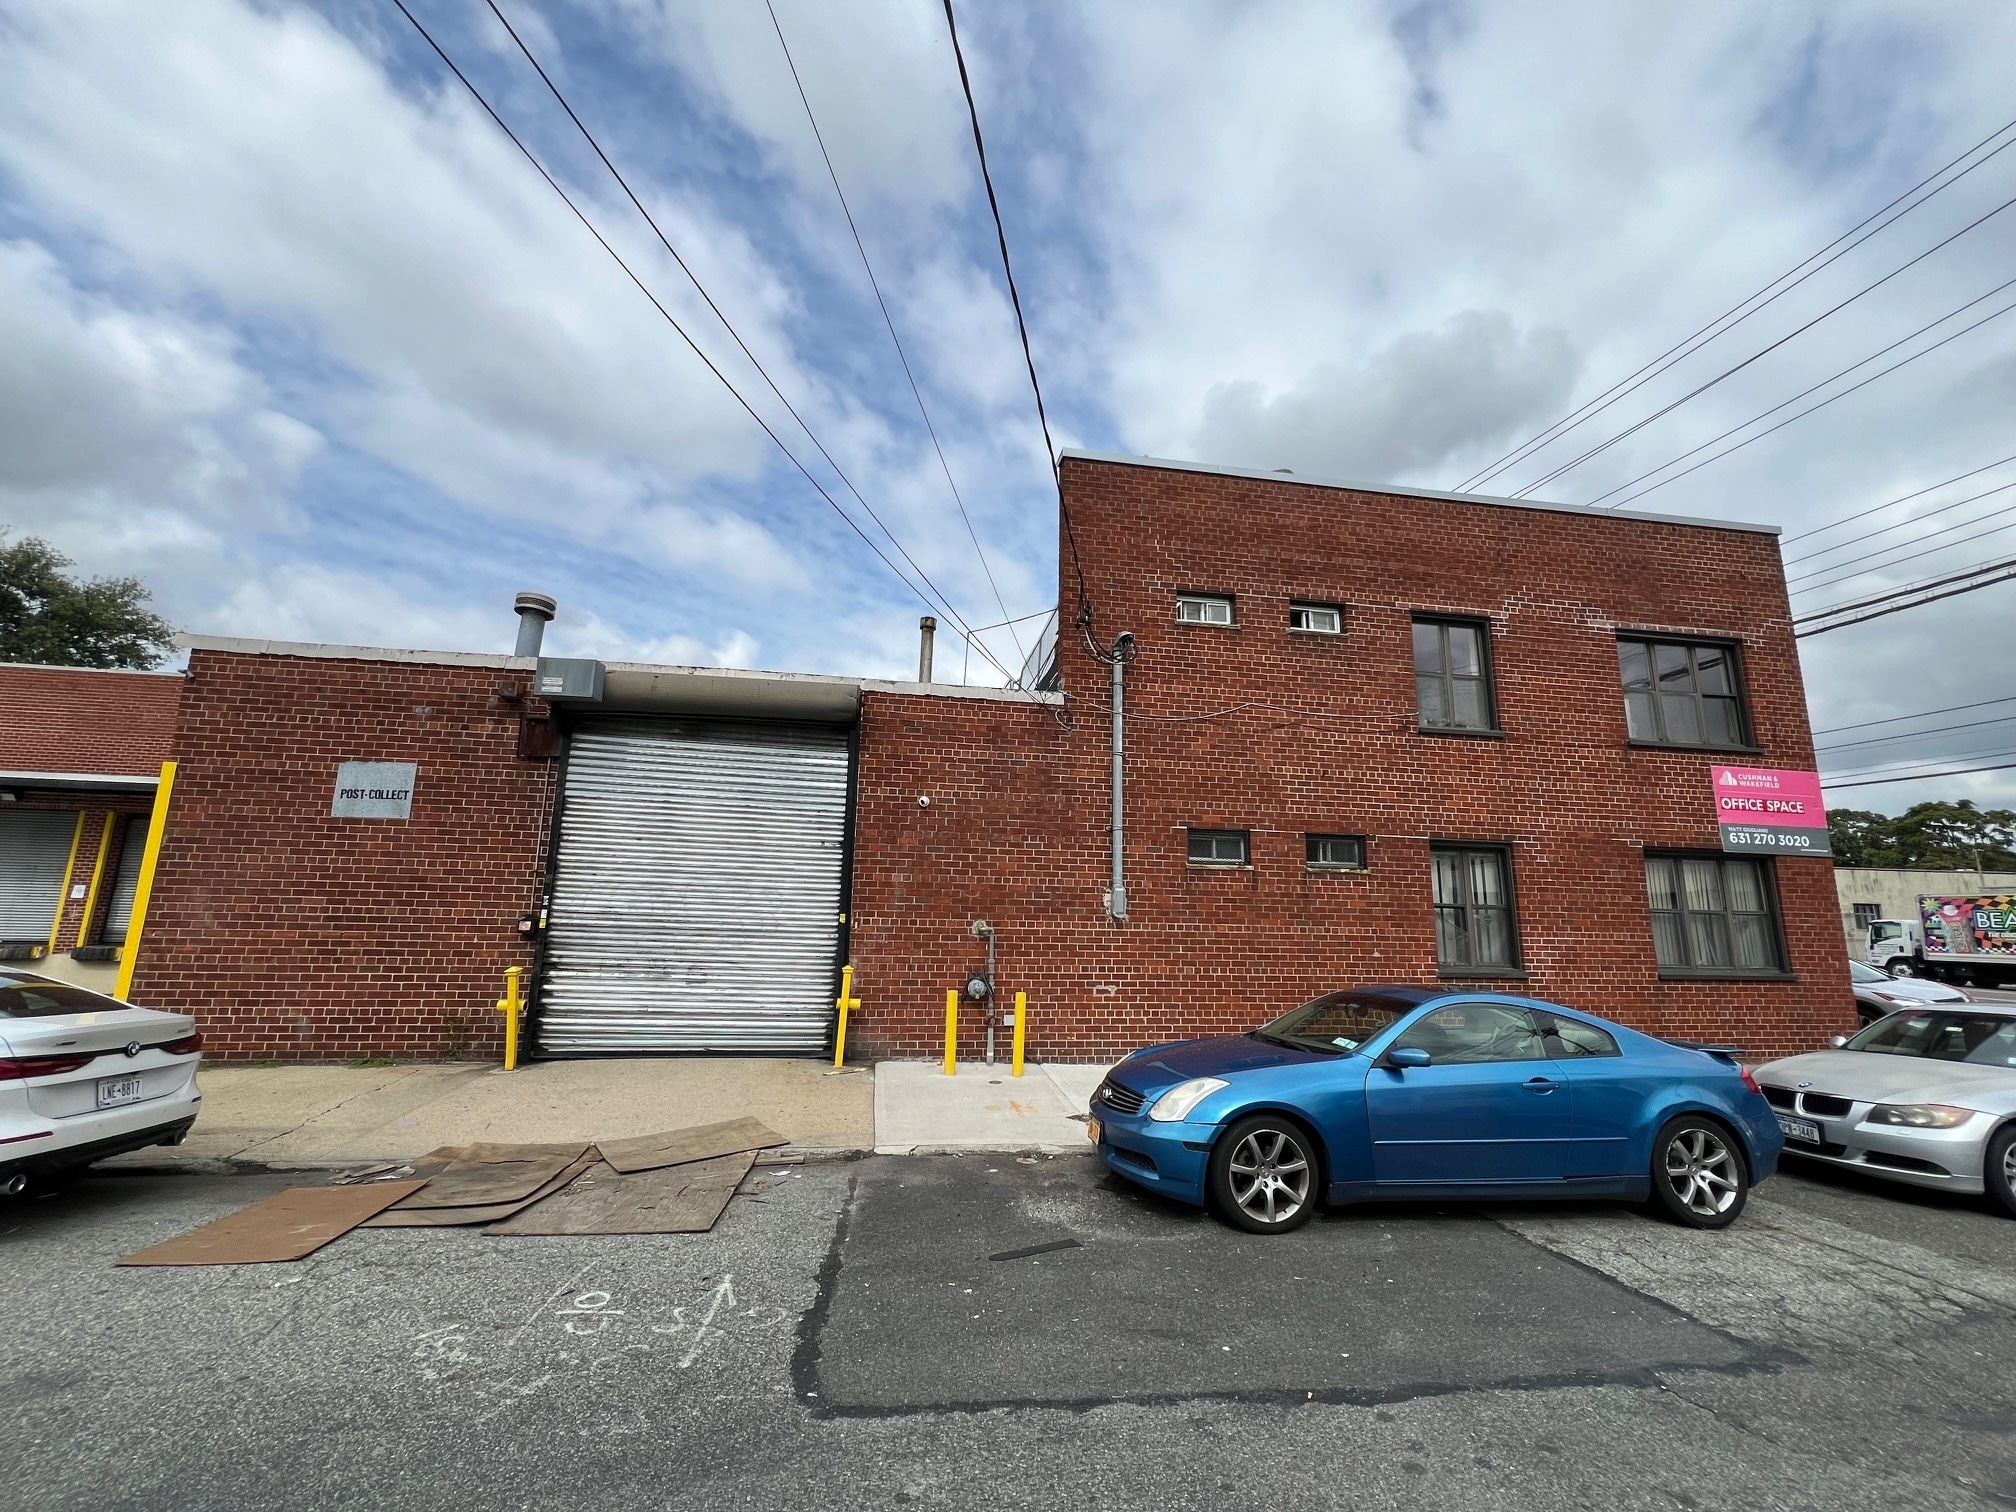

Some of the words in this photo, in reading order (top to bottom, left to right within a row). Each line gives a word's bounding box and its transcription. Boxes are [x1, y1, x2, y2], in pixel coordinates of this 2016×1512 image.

[1738, 774, 1772, 782] CUSHMAN
[1739, 780, 1780, 788] WAKEFIELD
[1721, 797, 1764, 811] OFFICE
[1766, 800, 1804, 813] SPACE
[1729, 832, 1751, 844] 631
[1754, 833, 1776, 846] 270
[1778, 834, 1810, 847] 3020
